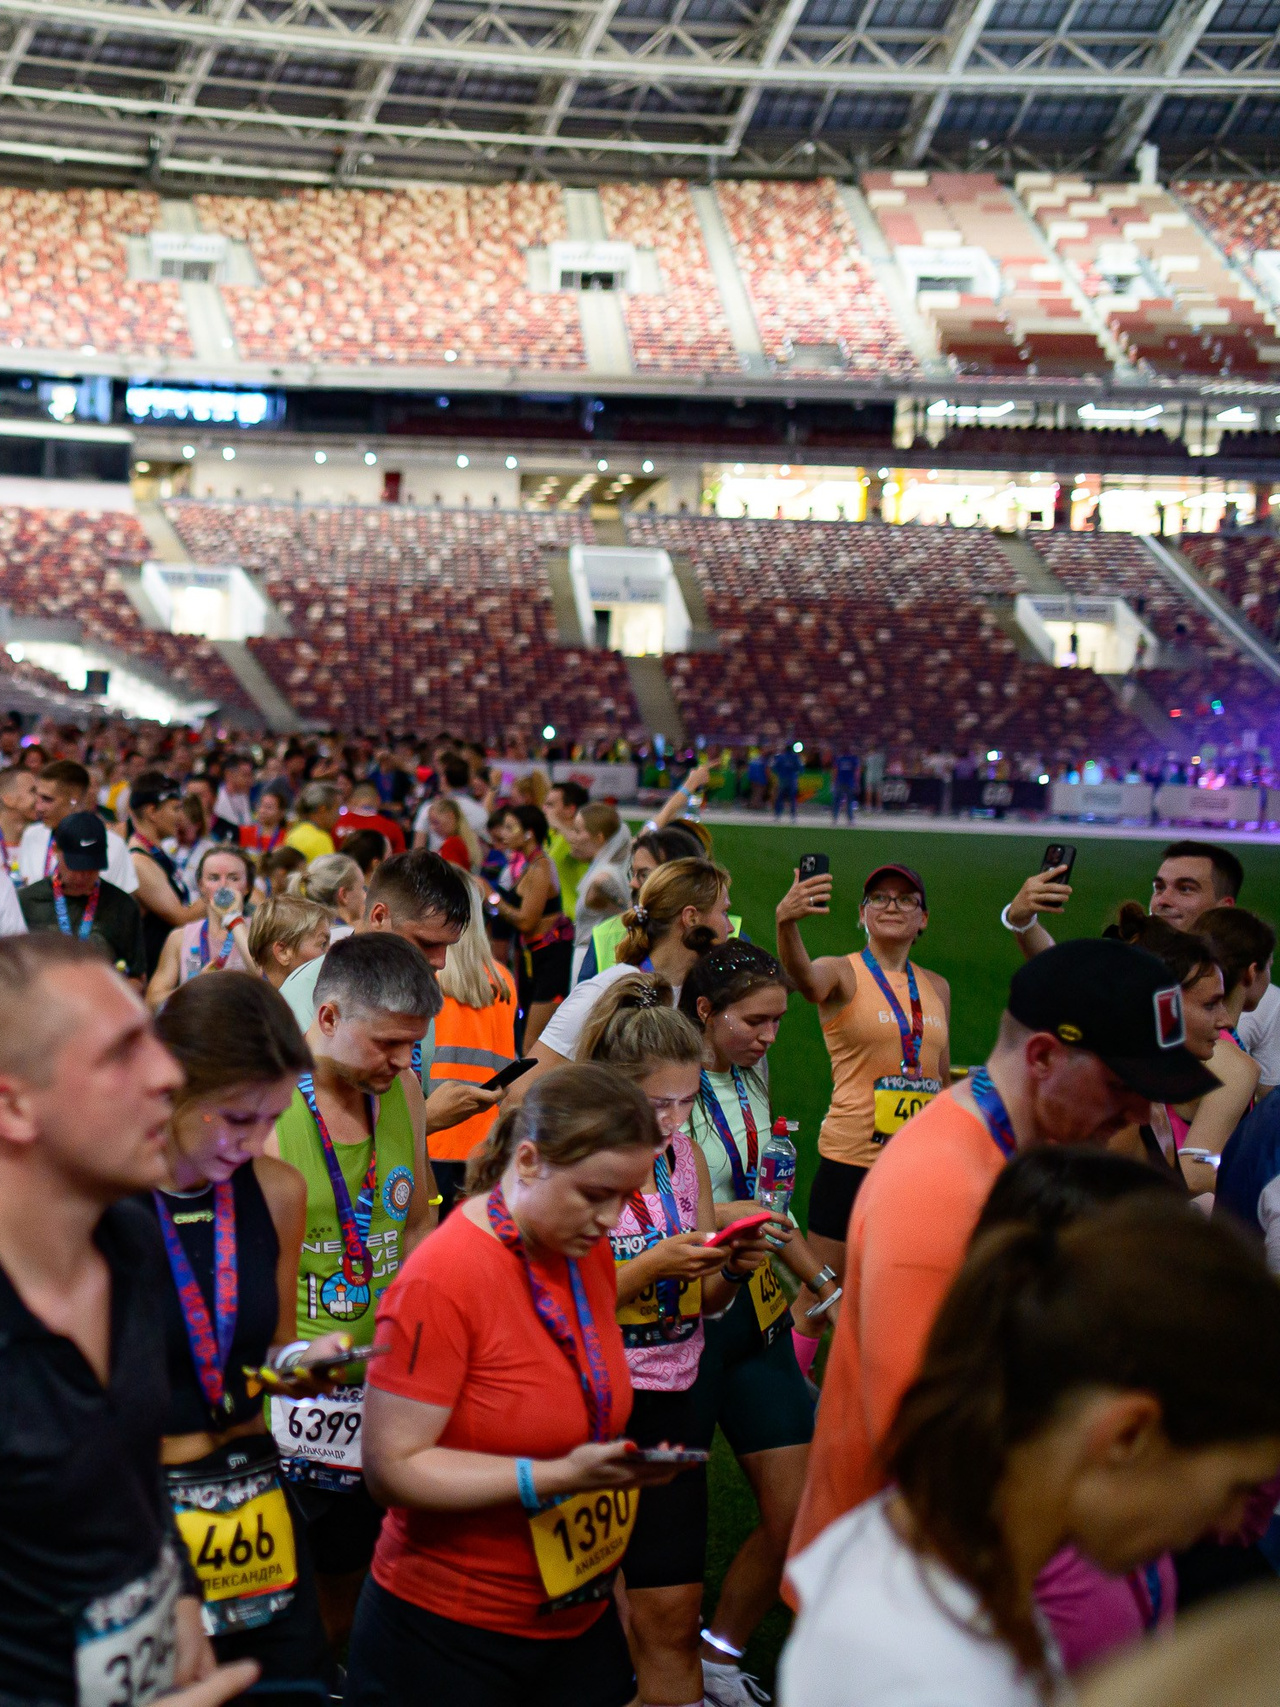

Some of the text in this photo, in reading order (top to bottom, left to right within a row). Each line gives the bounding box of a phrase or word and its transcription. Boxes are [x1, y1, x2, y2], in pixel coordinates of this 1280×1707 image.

[894, 1097, 933, 1121] 40
[302, 1230, 398, 1254] NEER
[288, 1406, 362, 1446] 6399
[197, 1513, 276, 1572] 466
[552, 1487, 631, 1563] 1390
[203, 1563, 284, 1591] ЛЕКСАНДРА
[105, 1635, 176, 1707] 32
